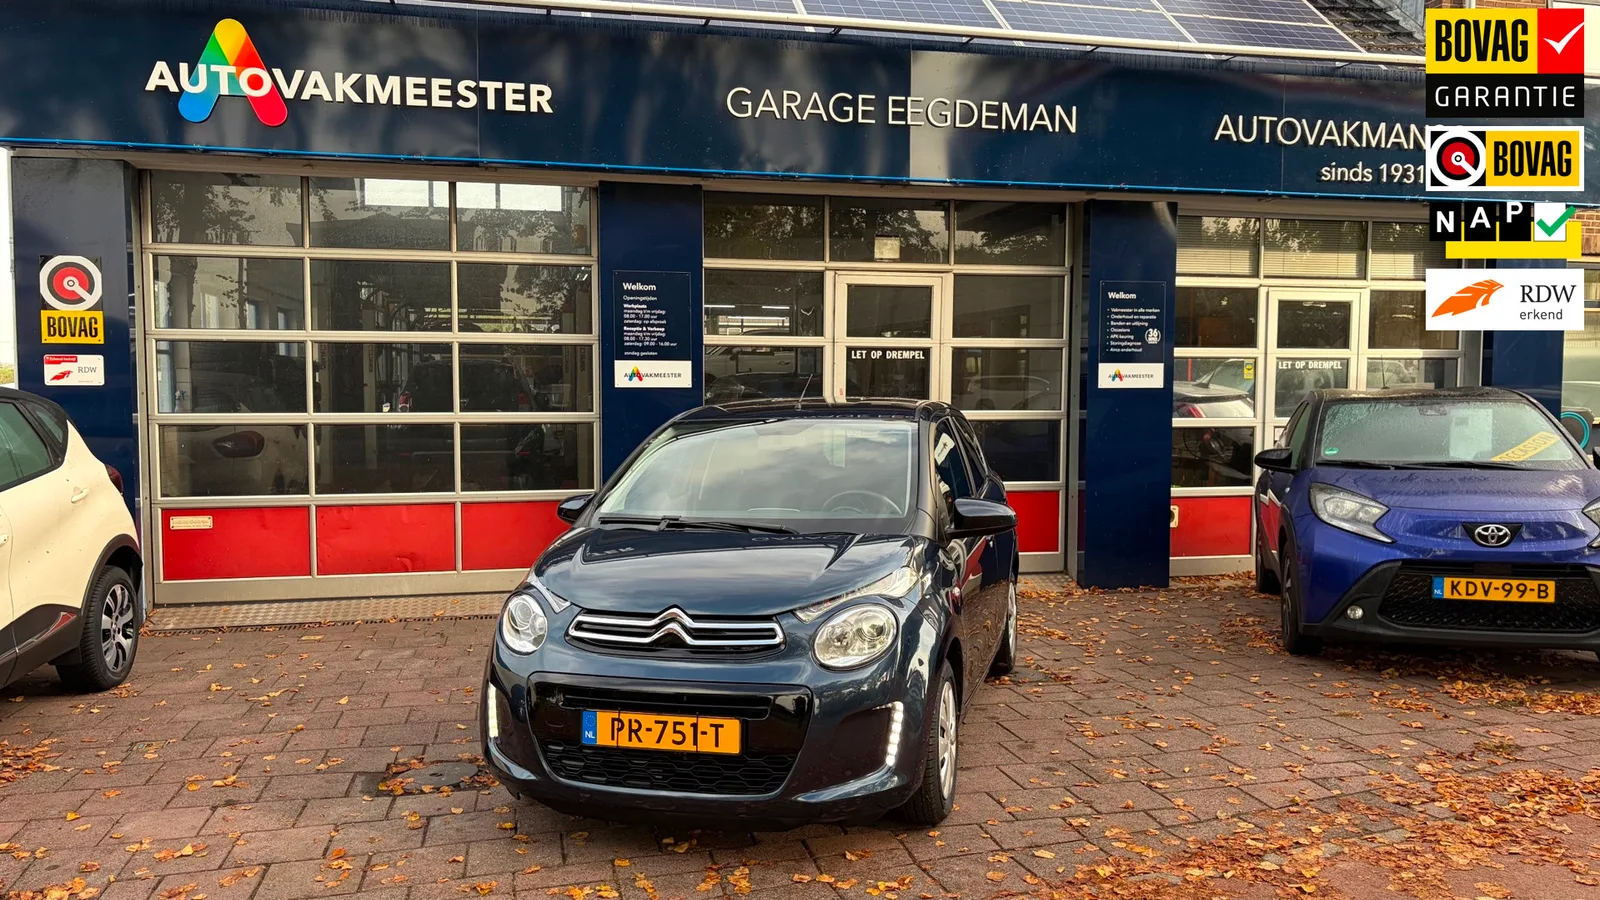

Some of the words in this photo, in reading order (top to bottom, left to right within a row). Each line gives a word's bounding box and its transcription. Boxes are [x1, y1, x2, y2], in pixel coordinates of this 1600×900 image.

[145, 61, 553, 113] AUTOVAKMEESTER
[726, 87, 876, 124] GARAGE
[888, 96, 1077, 133] EEGDEMAN
[1214, 114, 1464, 150] AUTOVAKMAN
[1320, 161, 1373, 182] sinds
[1379, 163, 1424, 184] 1931
[622, 282, 657, 291] Welkom
[1107, 291, 1137, 299] Welkom
[47, 316, 98, 338] BOVAG
[1147, 328, 1158, 337] 36
[851, 350, 867, 359] LET
[870, 350, 883, 359] OP
[885, 350, 925, 360] DREMPEL
[1278, 361, 1292, 369] LET
[1295, 361, 1306, 369] OP
[1308, 361, 1343, 370] DREMPEL
[1450, 580, 1549, 599] KDV-99-B
[584, 731, 595, 739] NL
[610, 717, 725, 748] PR-751-T
